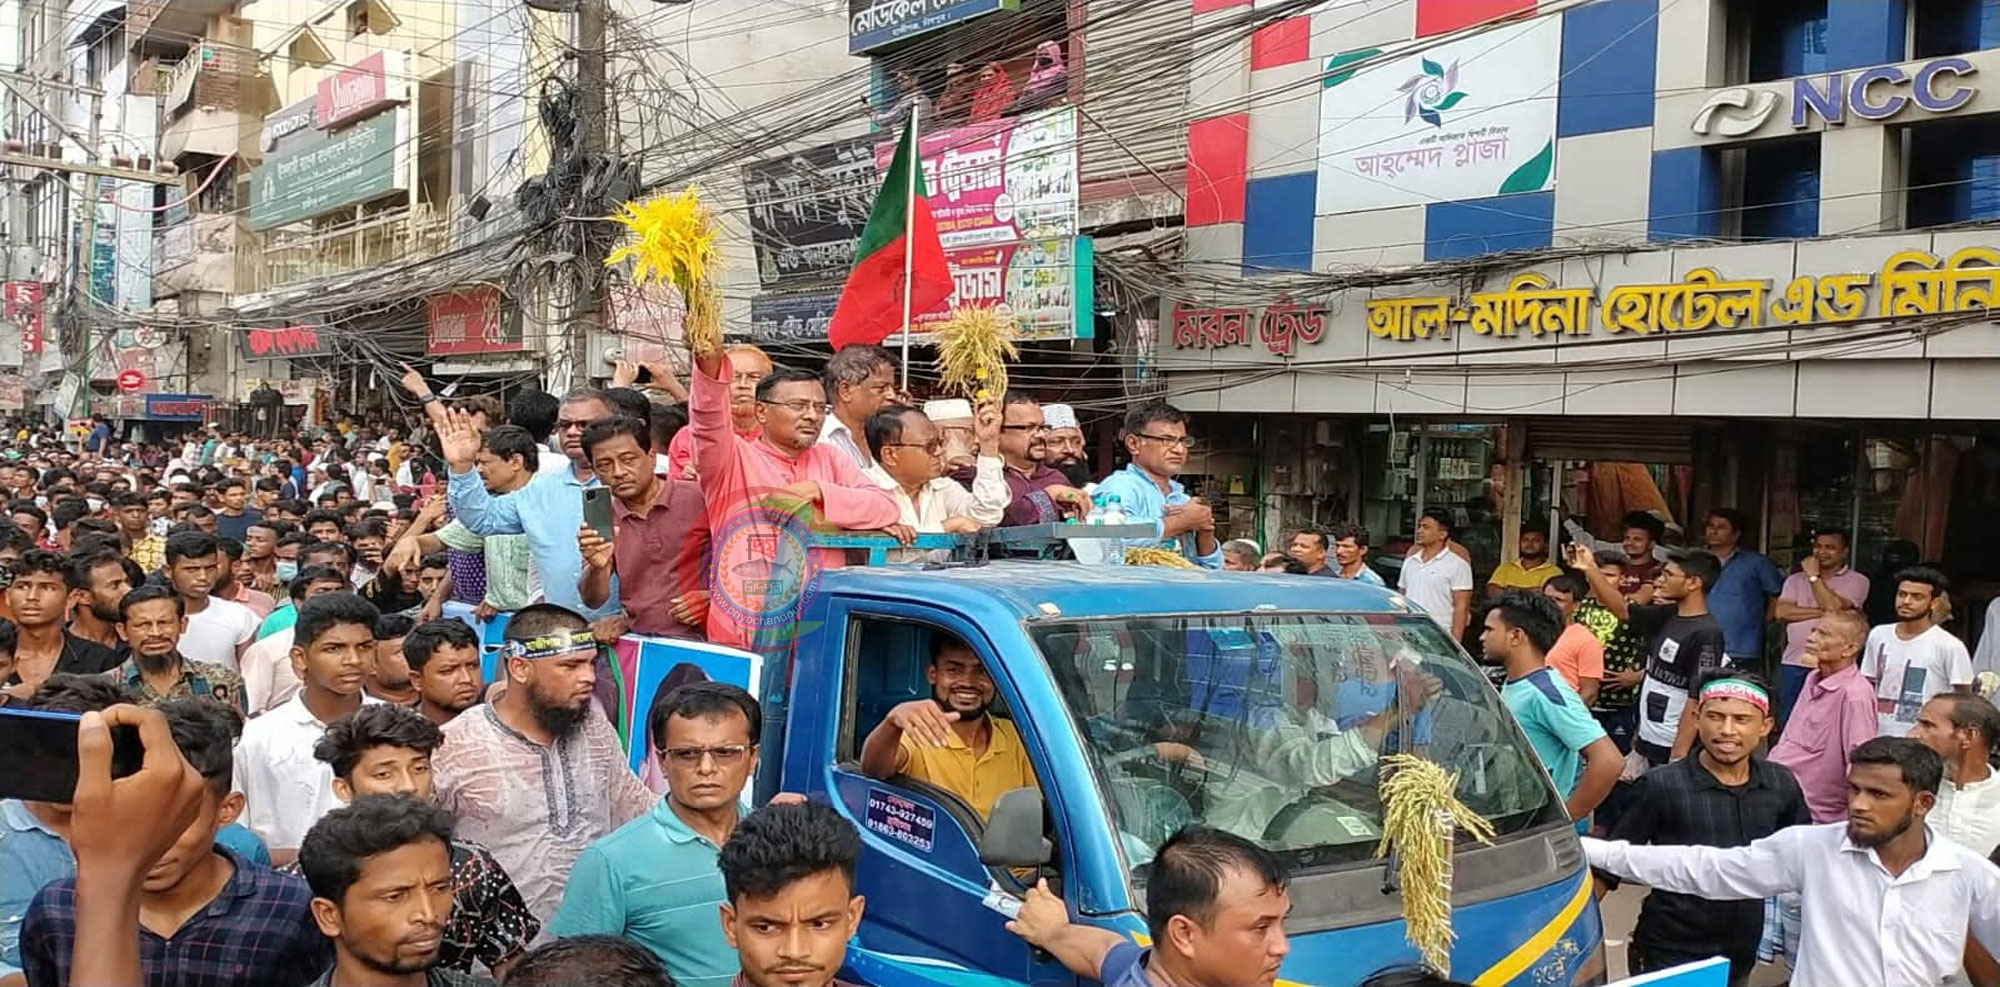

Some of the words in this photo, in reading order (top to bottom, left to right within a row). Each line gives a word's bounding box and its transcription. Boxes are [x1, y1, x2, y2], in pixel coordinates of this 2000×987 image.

[1790, 57, 1979, 129] NCC
[1452, 135, 1510, 168] প্লাজা
[1259, 292, 1328, 356] ট্রেড
[1367, 271, 1595, 340] আল-মদিনা
[1601, 266, 1767, 334] হোটেল
